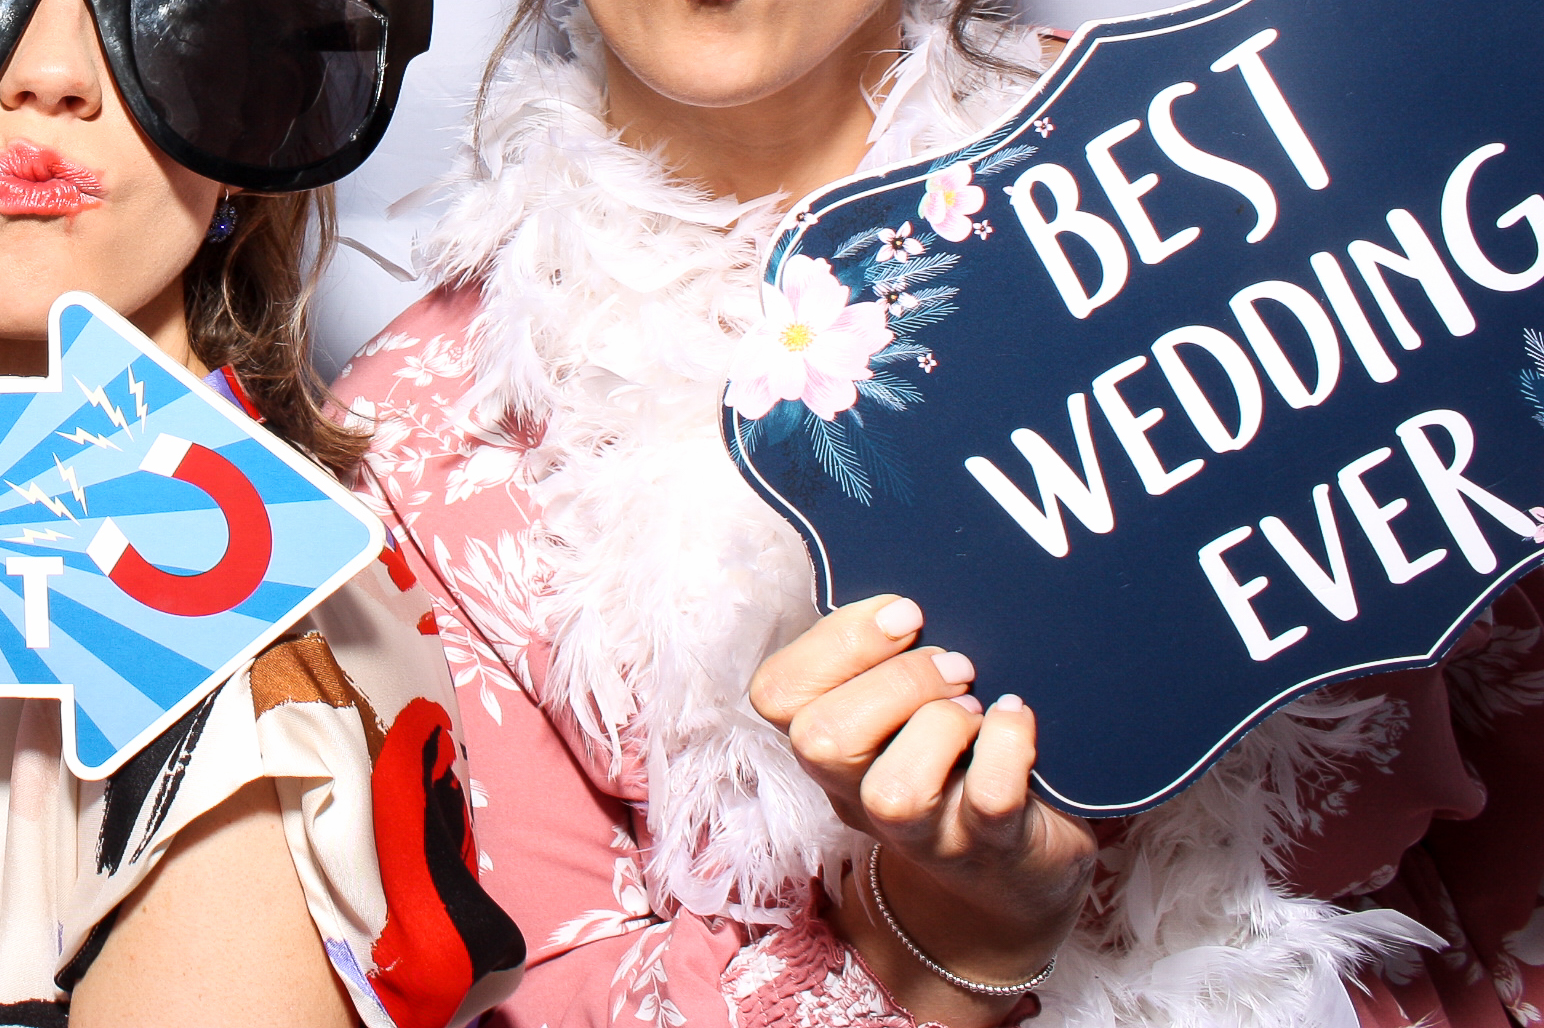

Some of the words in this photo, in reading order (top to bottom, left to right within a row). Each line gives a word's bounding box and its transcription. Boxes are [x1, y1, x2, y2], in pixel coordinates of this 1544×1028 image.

[1011, 28, 1331, 320] BEST
[964, 142, 1544, 559] WEDDING
[1198, 409, 1538, 662] EVER
